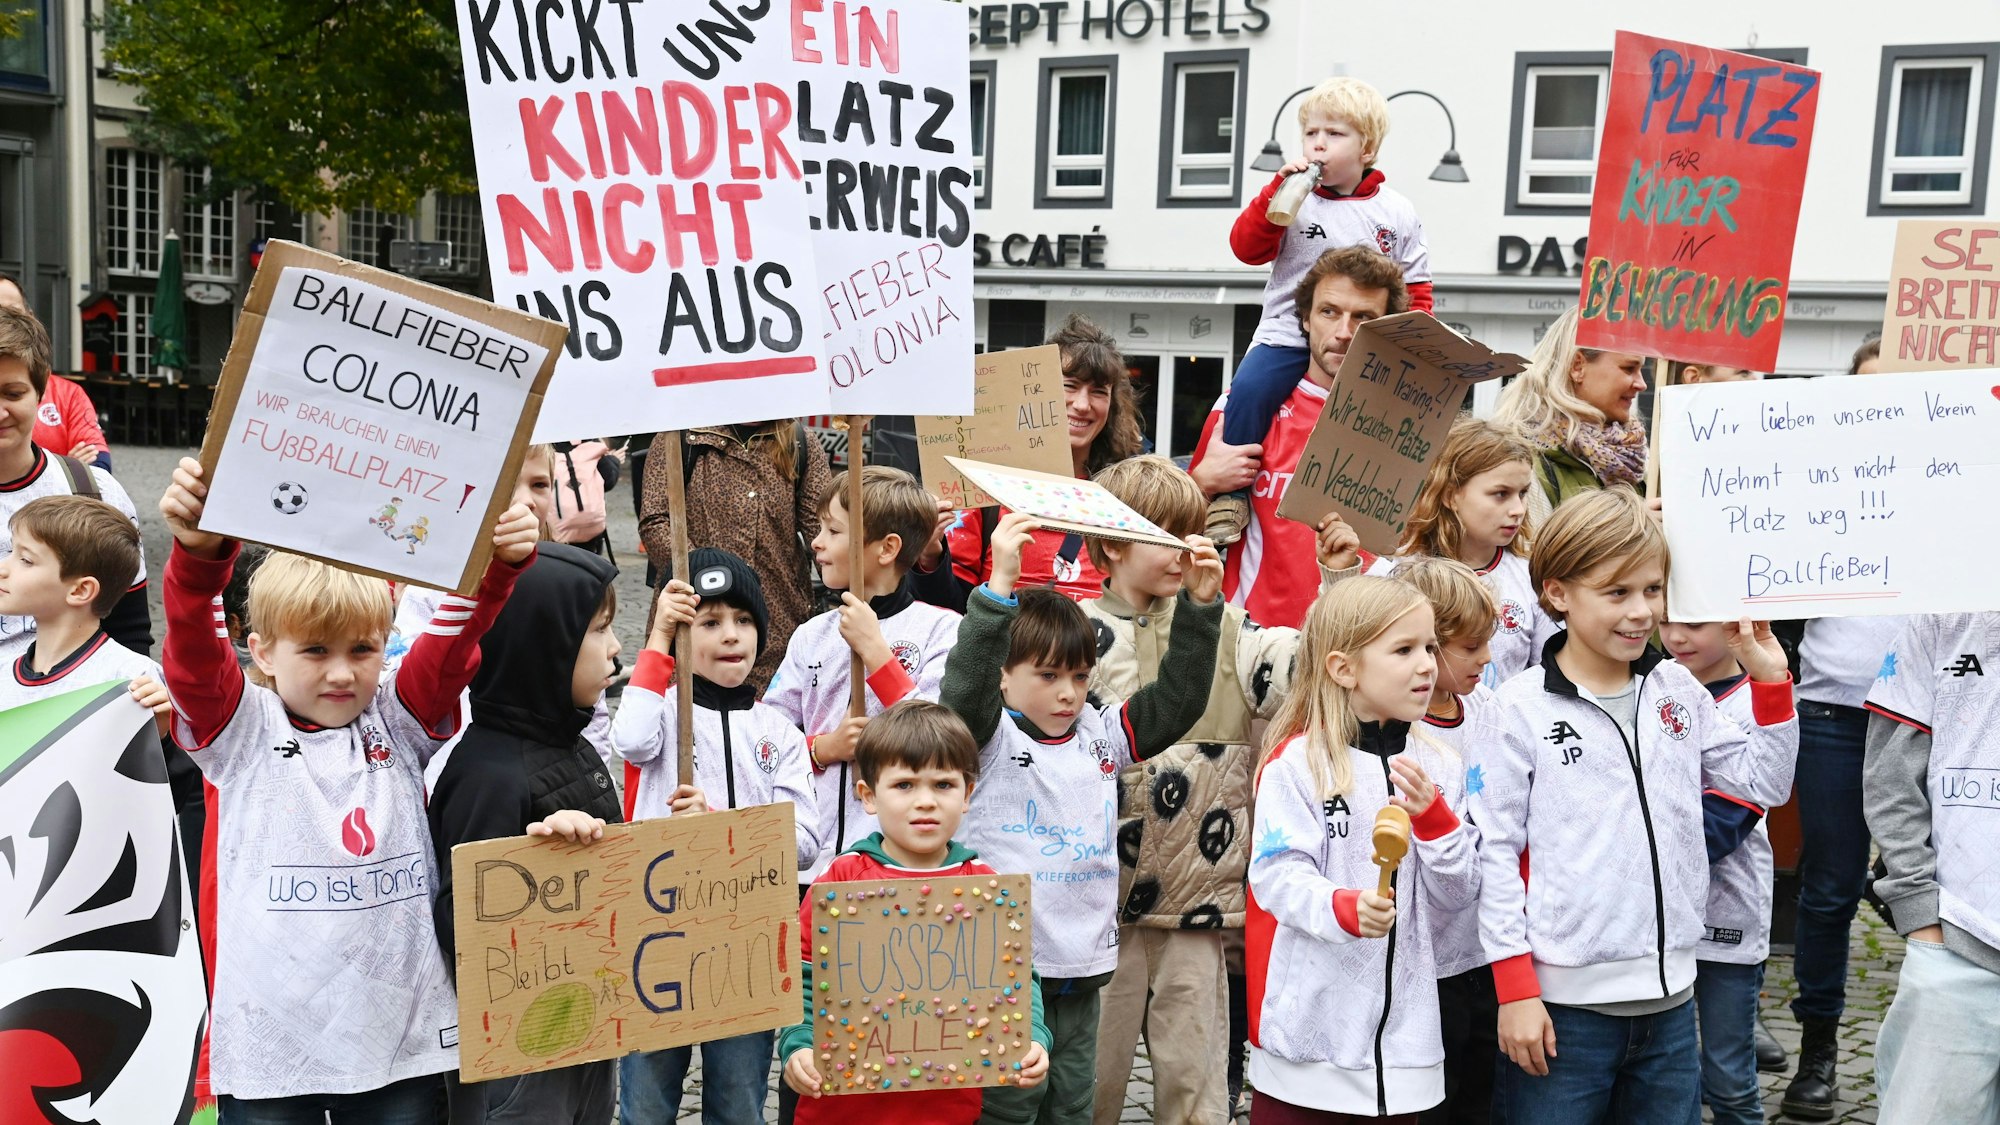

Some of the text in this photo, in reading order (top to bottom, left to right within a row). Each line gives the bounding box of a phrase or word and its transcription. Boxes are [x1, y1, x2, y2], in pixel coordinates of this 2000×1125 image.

[468, 0, 645, 84] KICKT
[791, 0, 900, 74] EIN
[969, 0, 1069, 45] EPT
[797, 80, 955, 154] LATZ
[1640, 48, 1818, 149] PLATZ
[518, 80, 803, 183] KINDER
[1663, 147, 1701, 172] FÜR
[496, 181, 763, 276] NICHT
[1002, 225, 1107, 268] CAFÉ
[1921, 228, 2000, 272] SE
[658, 261, 804, 357] AUS
[822, 242, 952, 340] FIEBER
[1070, 288, 1087, 298] Bar
[1104, 288, 1216, 300] Homemade Lemonade
[1528, 299, 1566, 311] Lunch
[1580, 256, 1784, 339] BEWEGUNG
[1792, 303, 1836, 318] Burger
[292, 275, 530, 378] BALLFIEBER
[828, 295, 961, 389] OLONIA
[1898, 323, 2000, 366] NICH
[302, 344, 480, 432] COLONIA
[1021, 362, 1041, 378] IST
[256, 389, 441, 460] WIR BRAUCHEN EINEN
[1018, 400, 1060, 431] ALLE
[1687, 407, 1740, 442] Wir
[1833, 405, 1905, 425] unseren
[1925, 391, 1976, 422] Verein
[1029, 436, 1045, 449] DA
[1391, 416, 1431, 464] Plätze
[1300, 454, 1322, 488] in
[1701, 455, 1962, 498] Nehmt uns nicht den
[1721, 504, 1786, 534] Platz
[1808, 509, 1848, 535] weg
[1561, 746, 1584, 766] JP
[1942, 776, 1981, 799] Wo
[1001, 799, 1086, 857] cologne
[268, 875, 317, 902] Wo
[326, 875, 363, 902] ist
[475, 860, 590, 922] Der
[486, 944, 575, 1004] Bleibt
[837, 912, 1001, 993] FUSSBALL
[863, 1018, 964, 1060] ALLE
